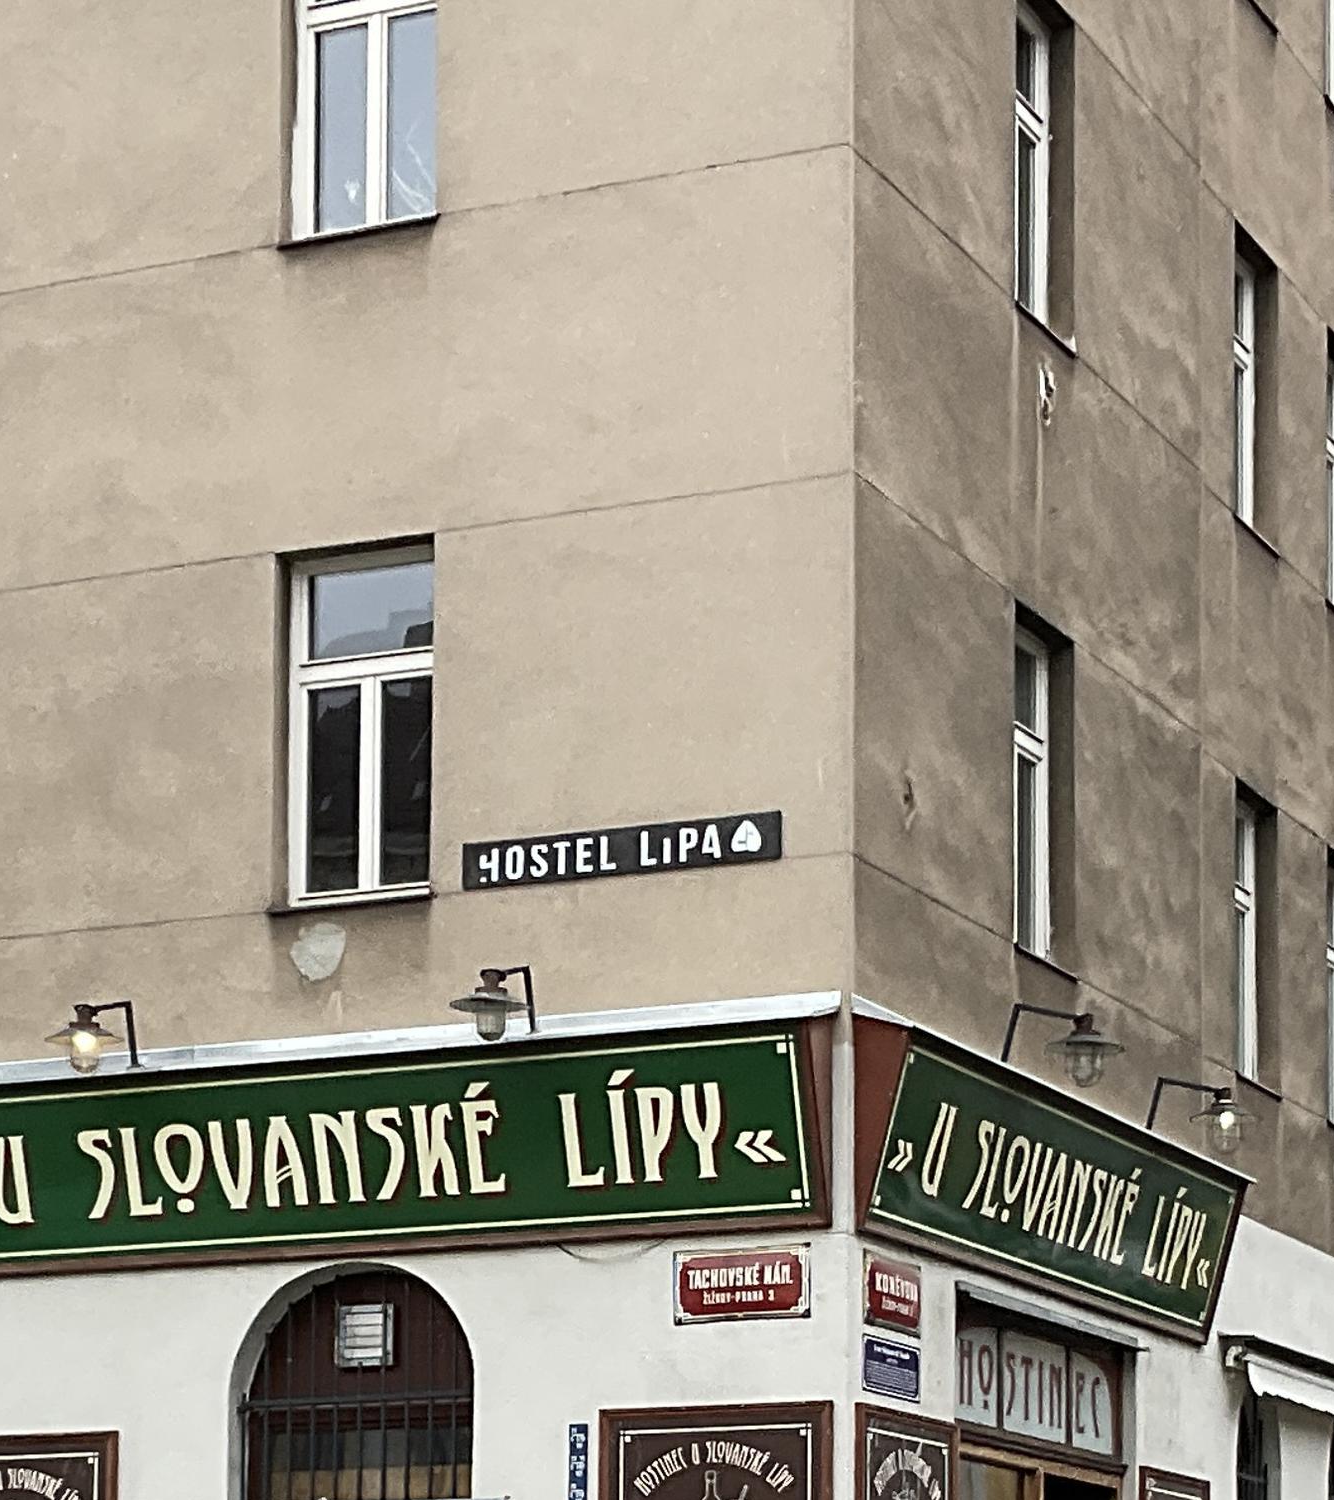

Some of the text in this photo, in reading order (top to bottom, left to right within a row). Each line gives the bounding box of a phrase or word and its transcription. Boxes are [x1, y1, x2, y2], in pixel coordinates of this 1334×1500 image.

[478, 835, 617, 884] HOSTEL
[76, 1080, 507, 1220] SLOVANSKÉ
[920, 1102, 959, 1198] U
[962, 1117, 1143, 1267] SLOVANSKÉ
[686, 1260, 795, 1291] TACHOVSKÉ NÁM.
[959, 1338, 1101, 1439] HOSTINEC
[633, 1446, 688, 1498] HOSTINEC
[705, 1440, 771, 1477] SLOVANSKÉ
